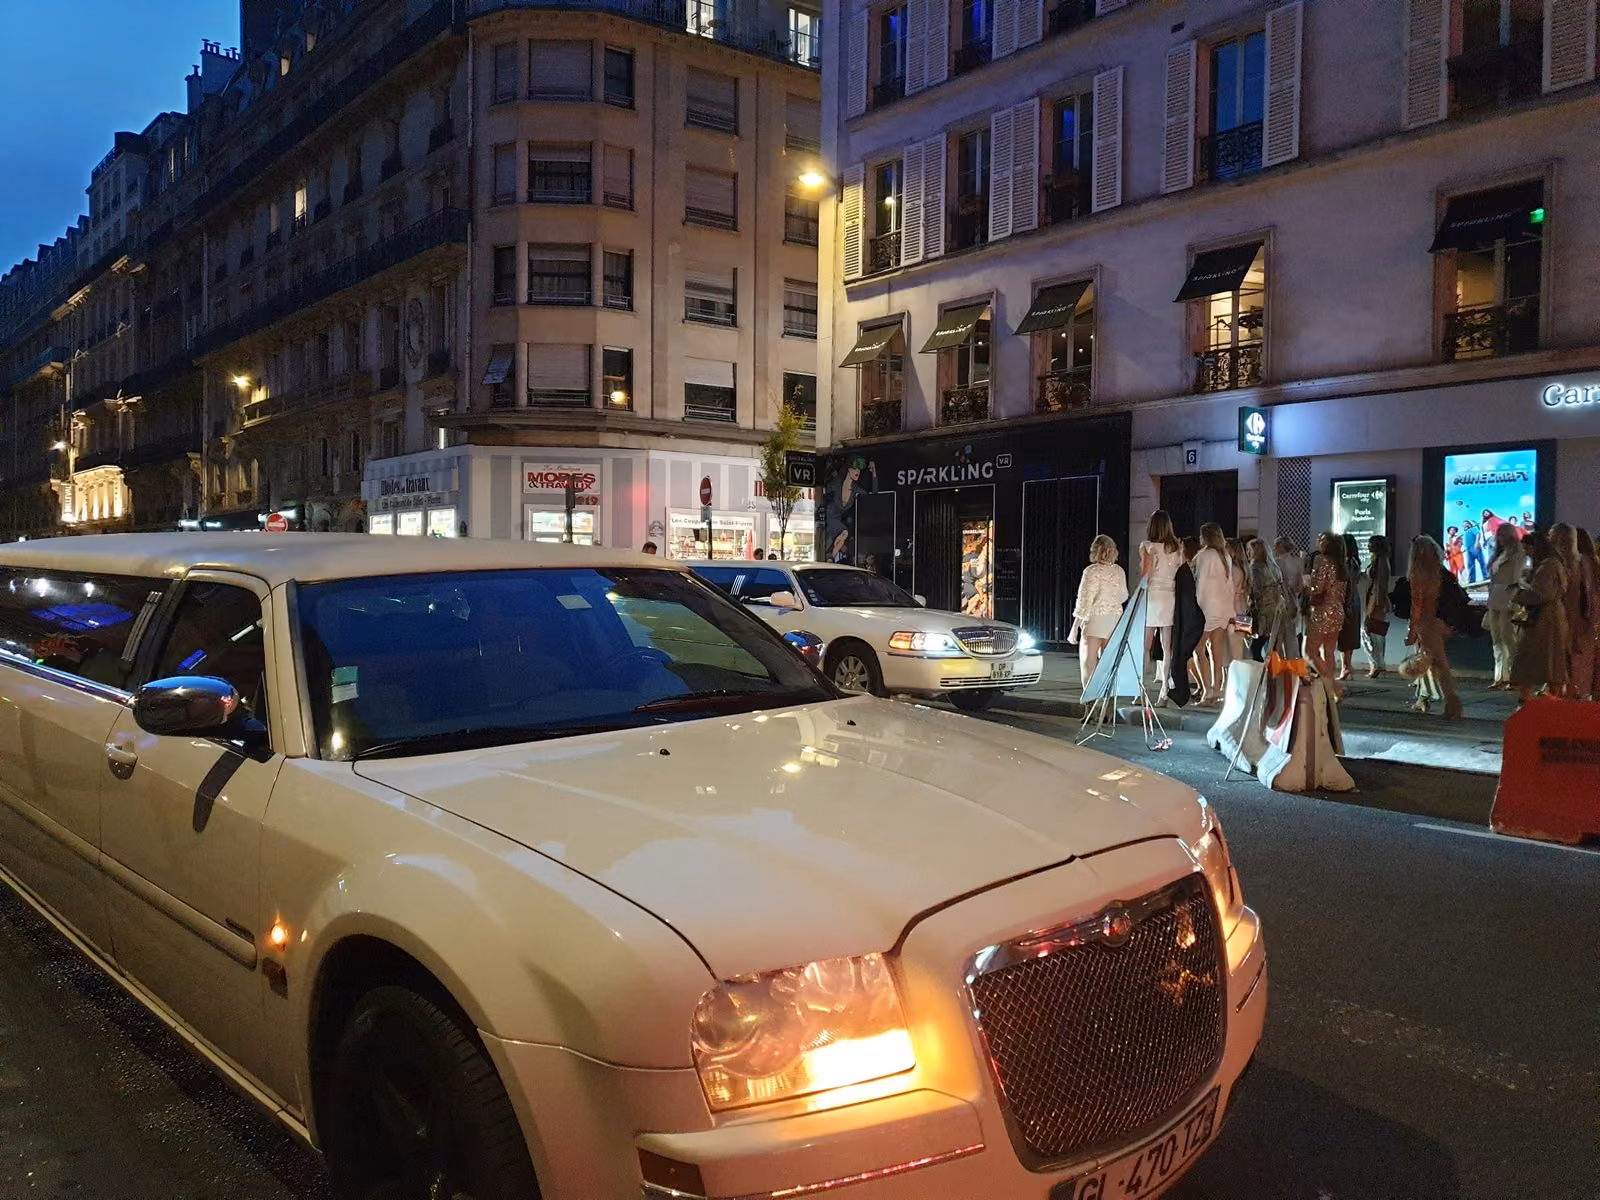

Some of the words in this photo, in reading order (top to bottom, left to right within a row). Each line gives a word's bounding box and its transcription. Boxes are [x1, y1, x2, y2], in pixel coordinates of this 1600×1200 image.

[1543, 383, 1600, 407] Car
[1188, 451, 1195, 462] 6
[793, 468, 811, 481] VR
